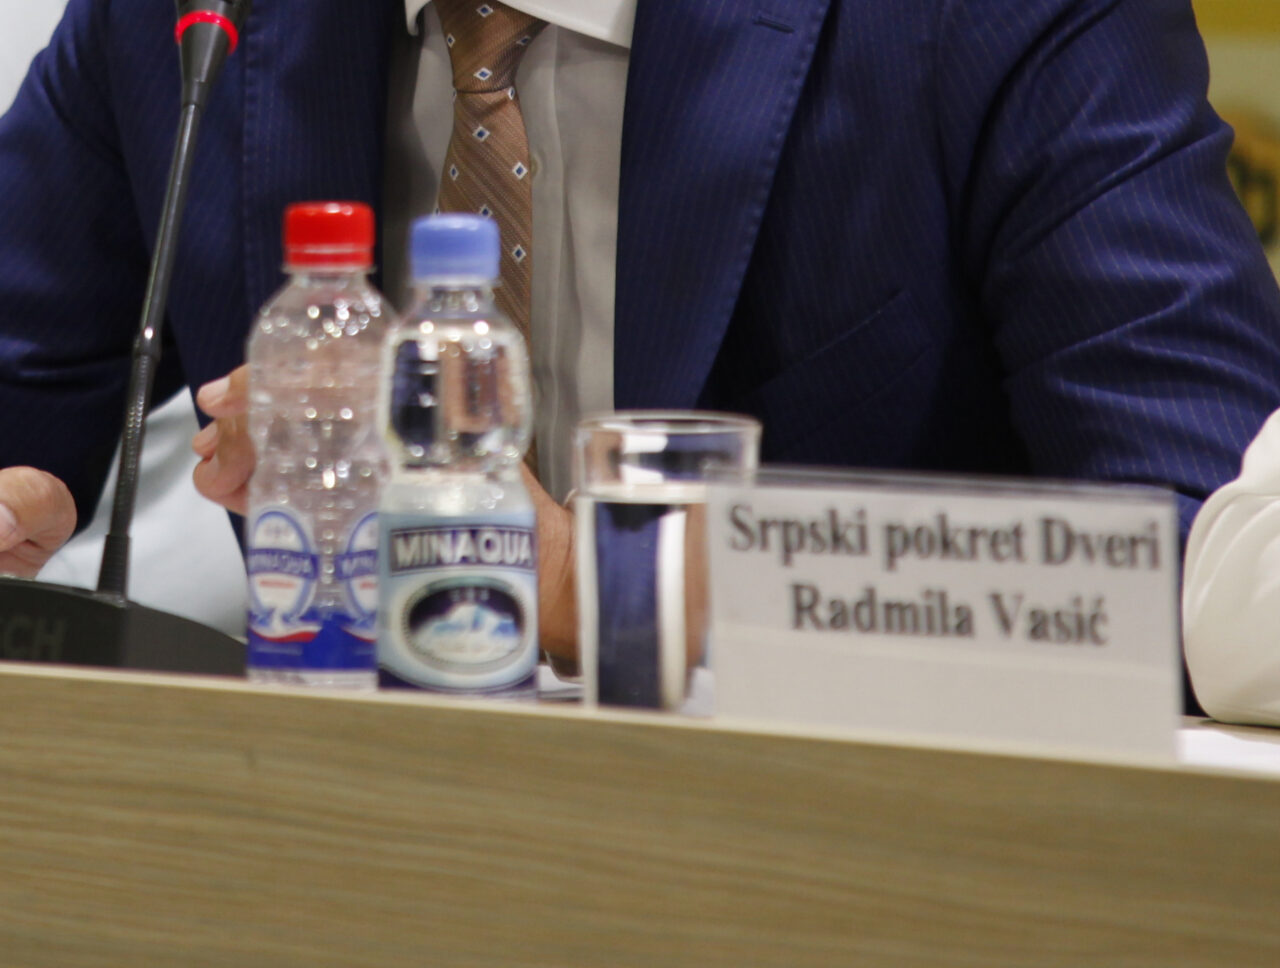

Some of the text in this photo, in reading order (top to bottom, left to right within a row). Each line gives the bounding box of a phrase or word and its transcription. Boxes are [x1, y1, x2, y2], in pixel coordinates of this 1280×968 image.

[394, 528, 533, 567] MINAQUA
[727, 504, 1162, 573] Srpski pokret Dveri
[790, 582, 1110, 647] Radmila Vasić
